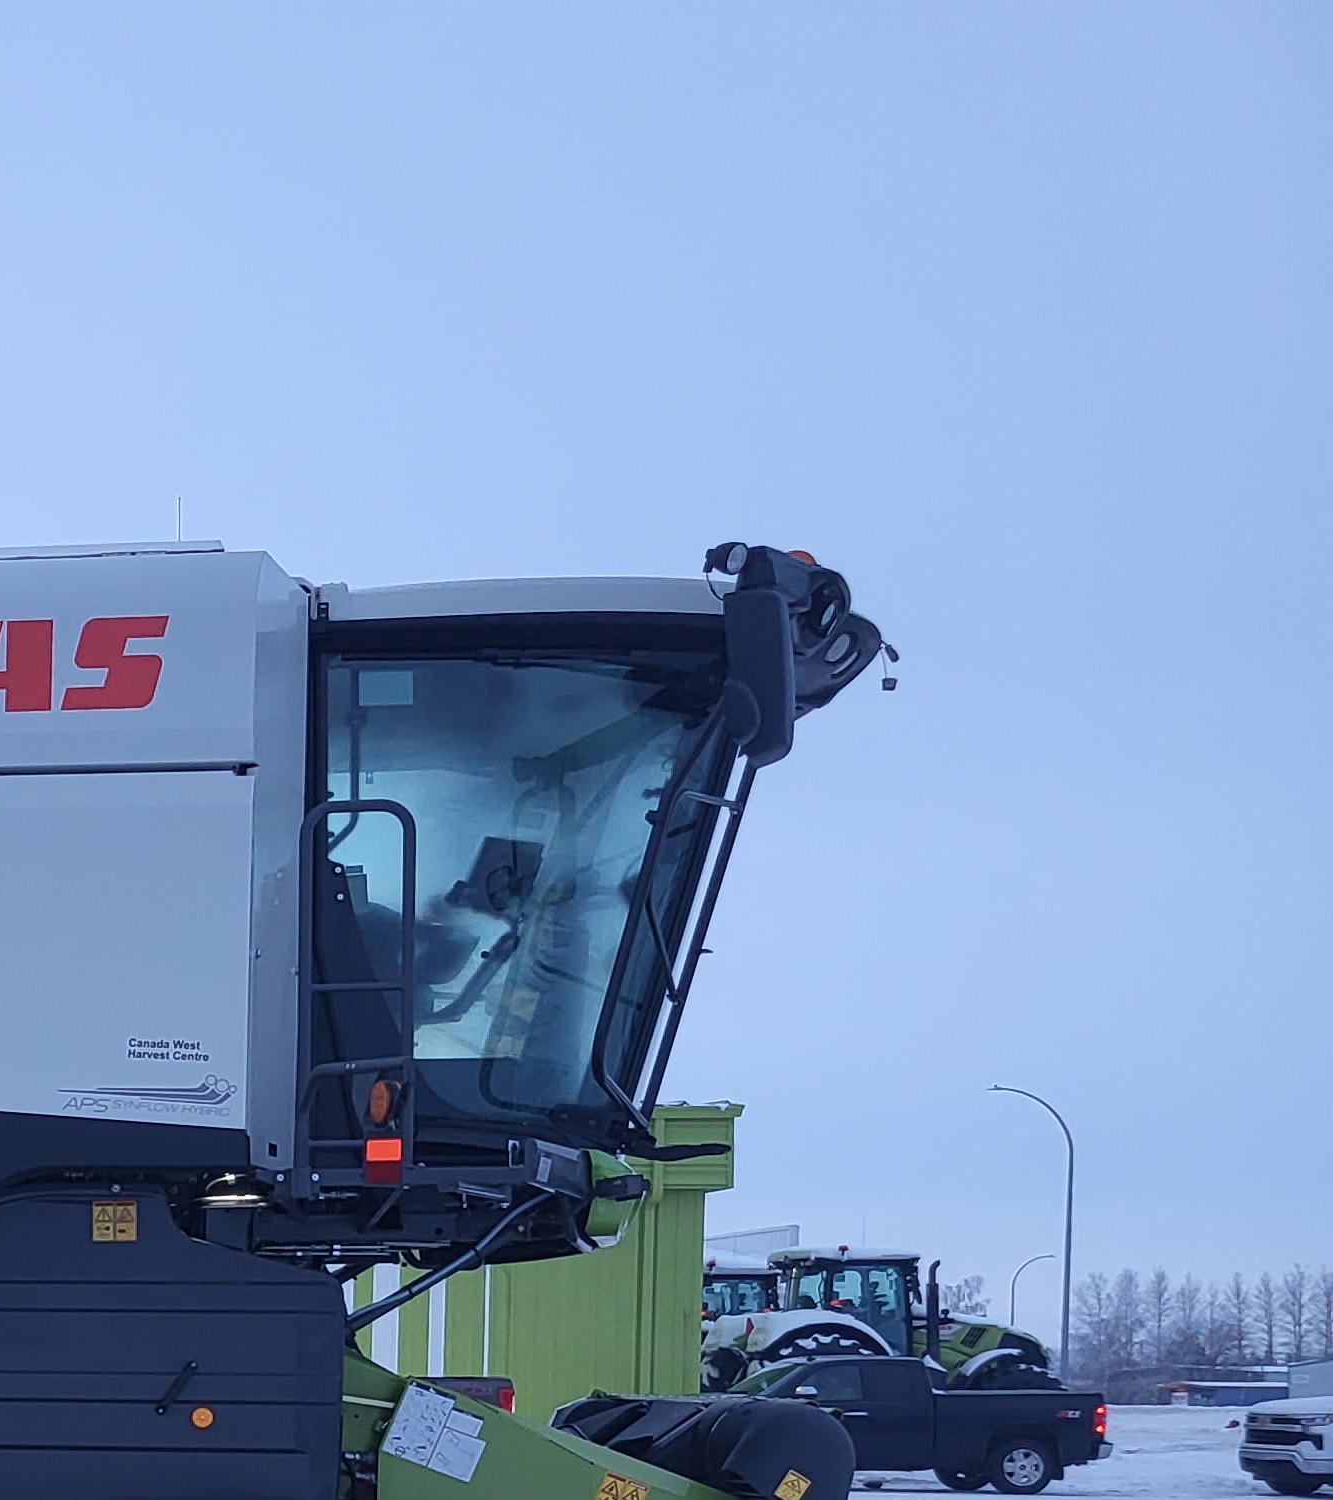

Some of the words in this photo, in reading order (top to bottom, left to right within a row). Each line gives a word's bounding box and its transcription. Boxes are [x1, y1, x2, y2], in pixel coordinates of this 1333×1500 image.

[128, 1037, 170, 1049] Canada
[172, 1039, 201, 1050] West
[127, 1048, 170, 1060] Harvest
[172, 1050, 210, 1062] Centre
[62, 1096, 112, 1113] APS
[112, 1100, 180, 1113] SYNFLOW
[180, 1106, 232, 1117] HYBRID
